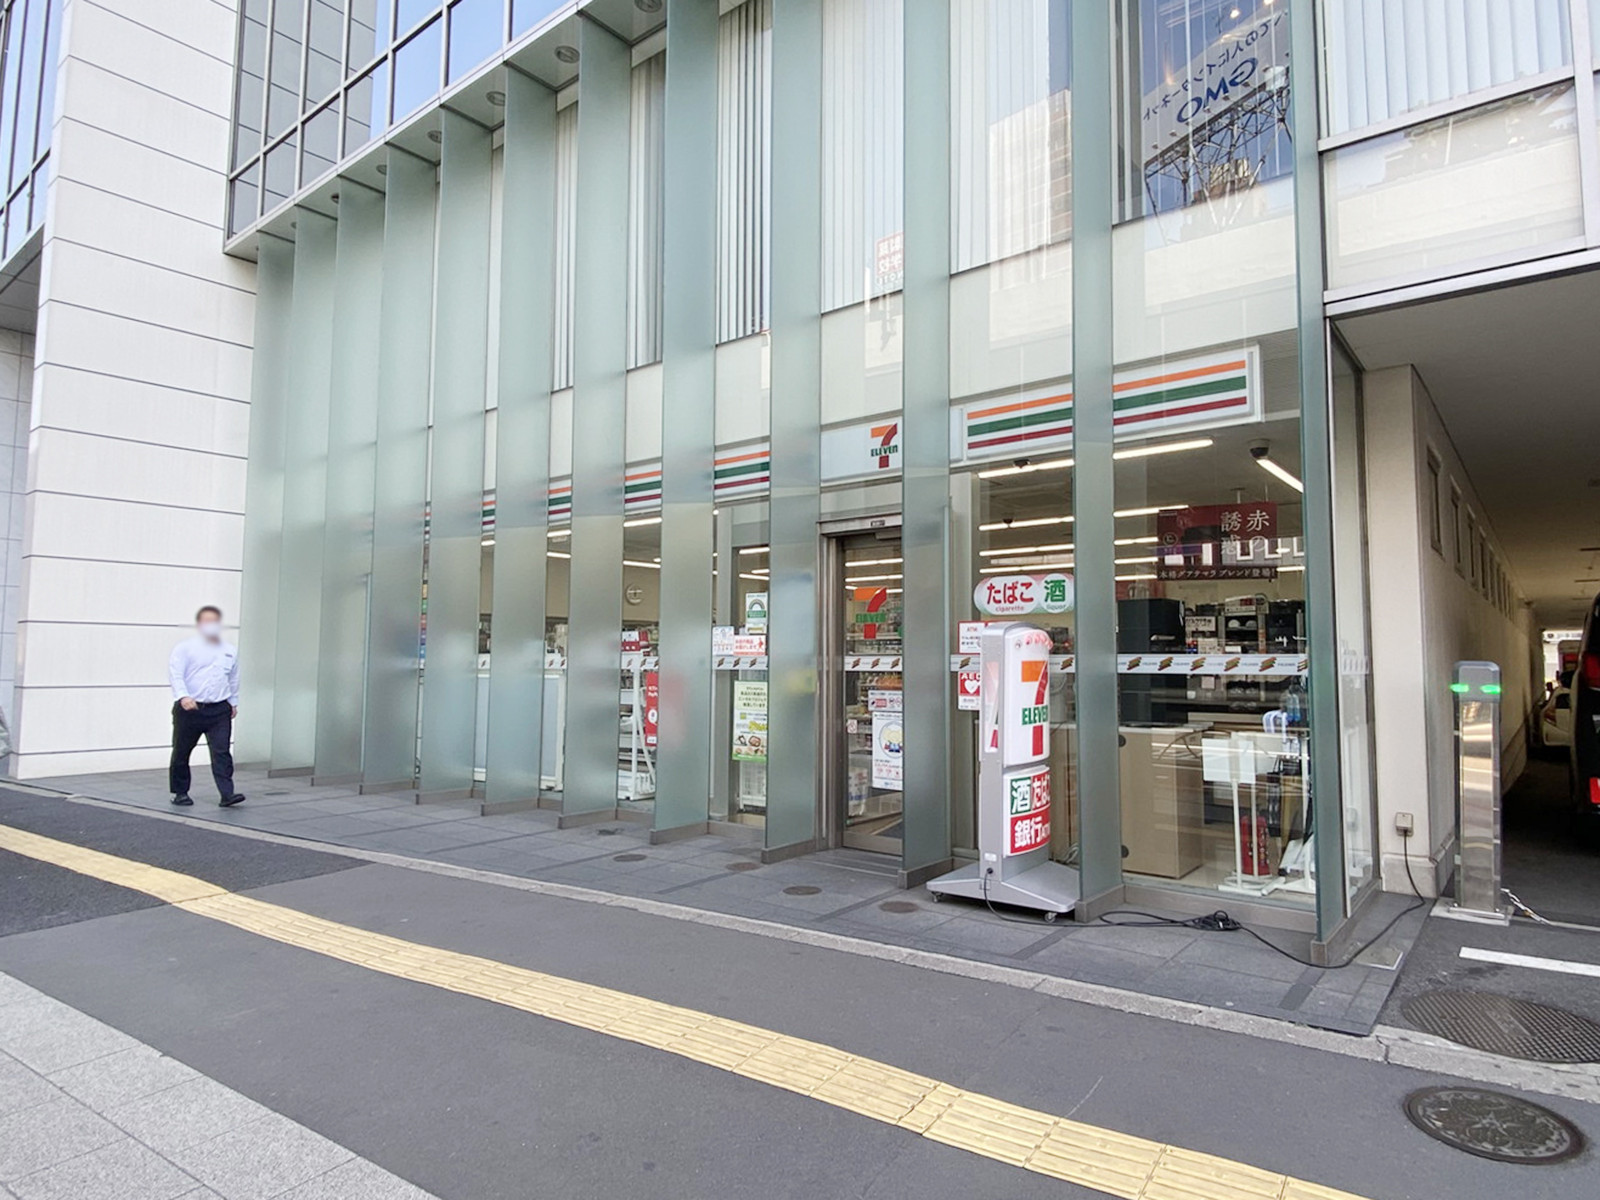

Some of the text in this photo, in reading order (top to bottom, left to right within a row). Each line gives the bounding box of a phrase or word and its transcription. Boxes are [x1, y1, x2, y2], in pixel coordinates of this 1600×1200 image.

[871, 422, 898, 468] 7
[987, 579, 1066, 605] たばこ 酒
[995, 605, 1025, 613] cigarette
[854, 587, 887, 639] 7
[1021, 660, 1049, 757] 7
[1012, 779, 1031, 814] 酒
